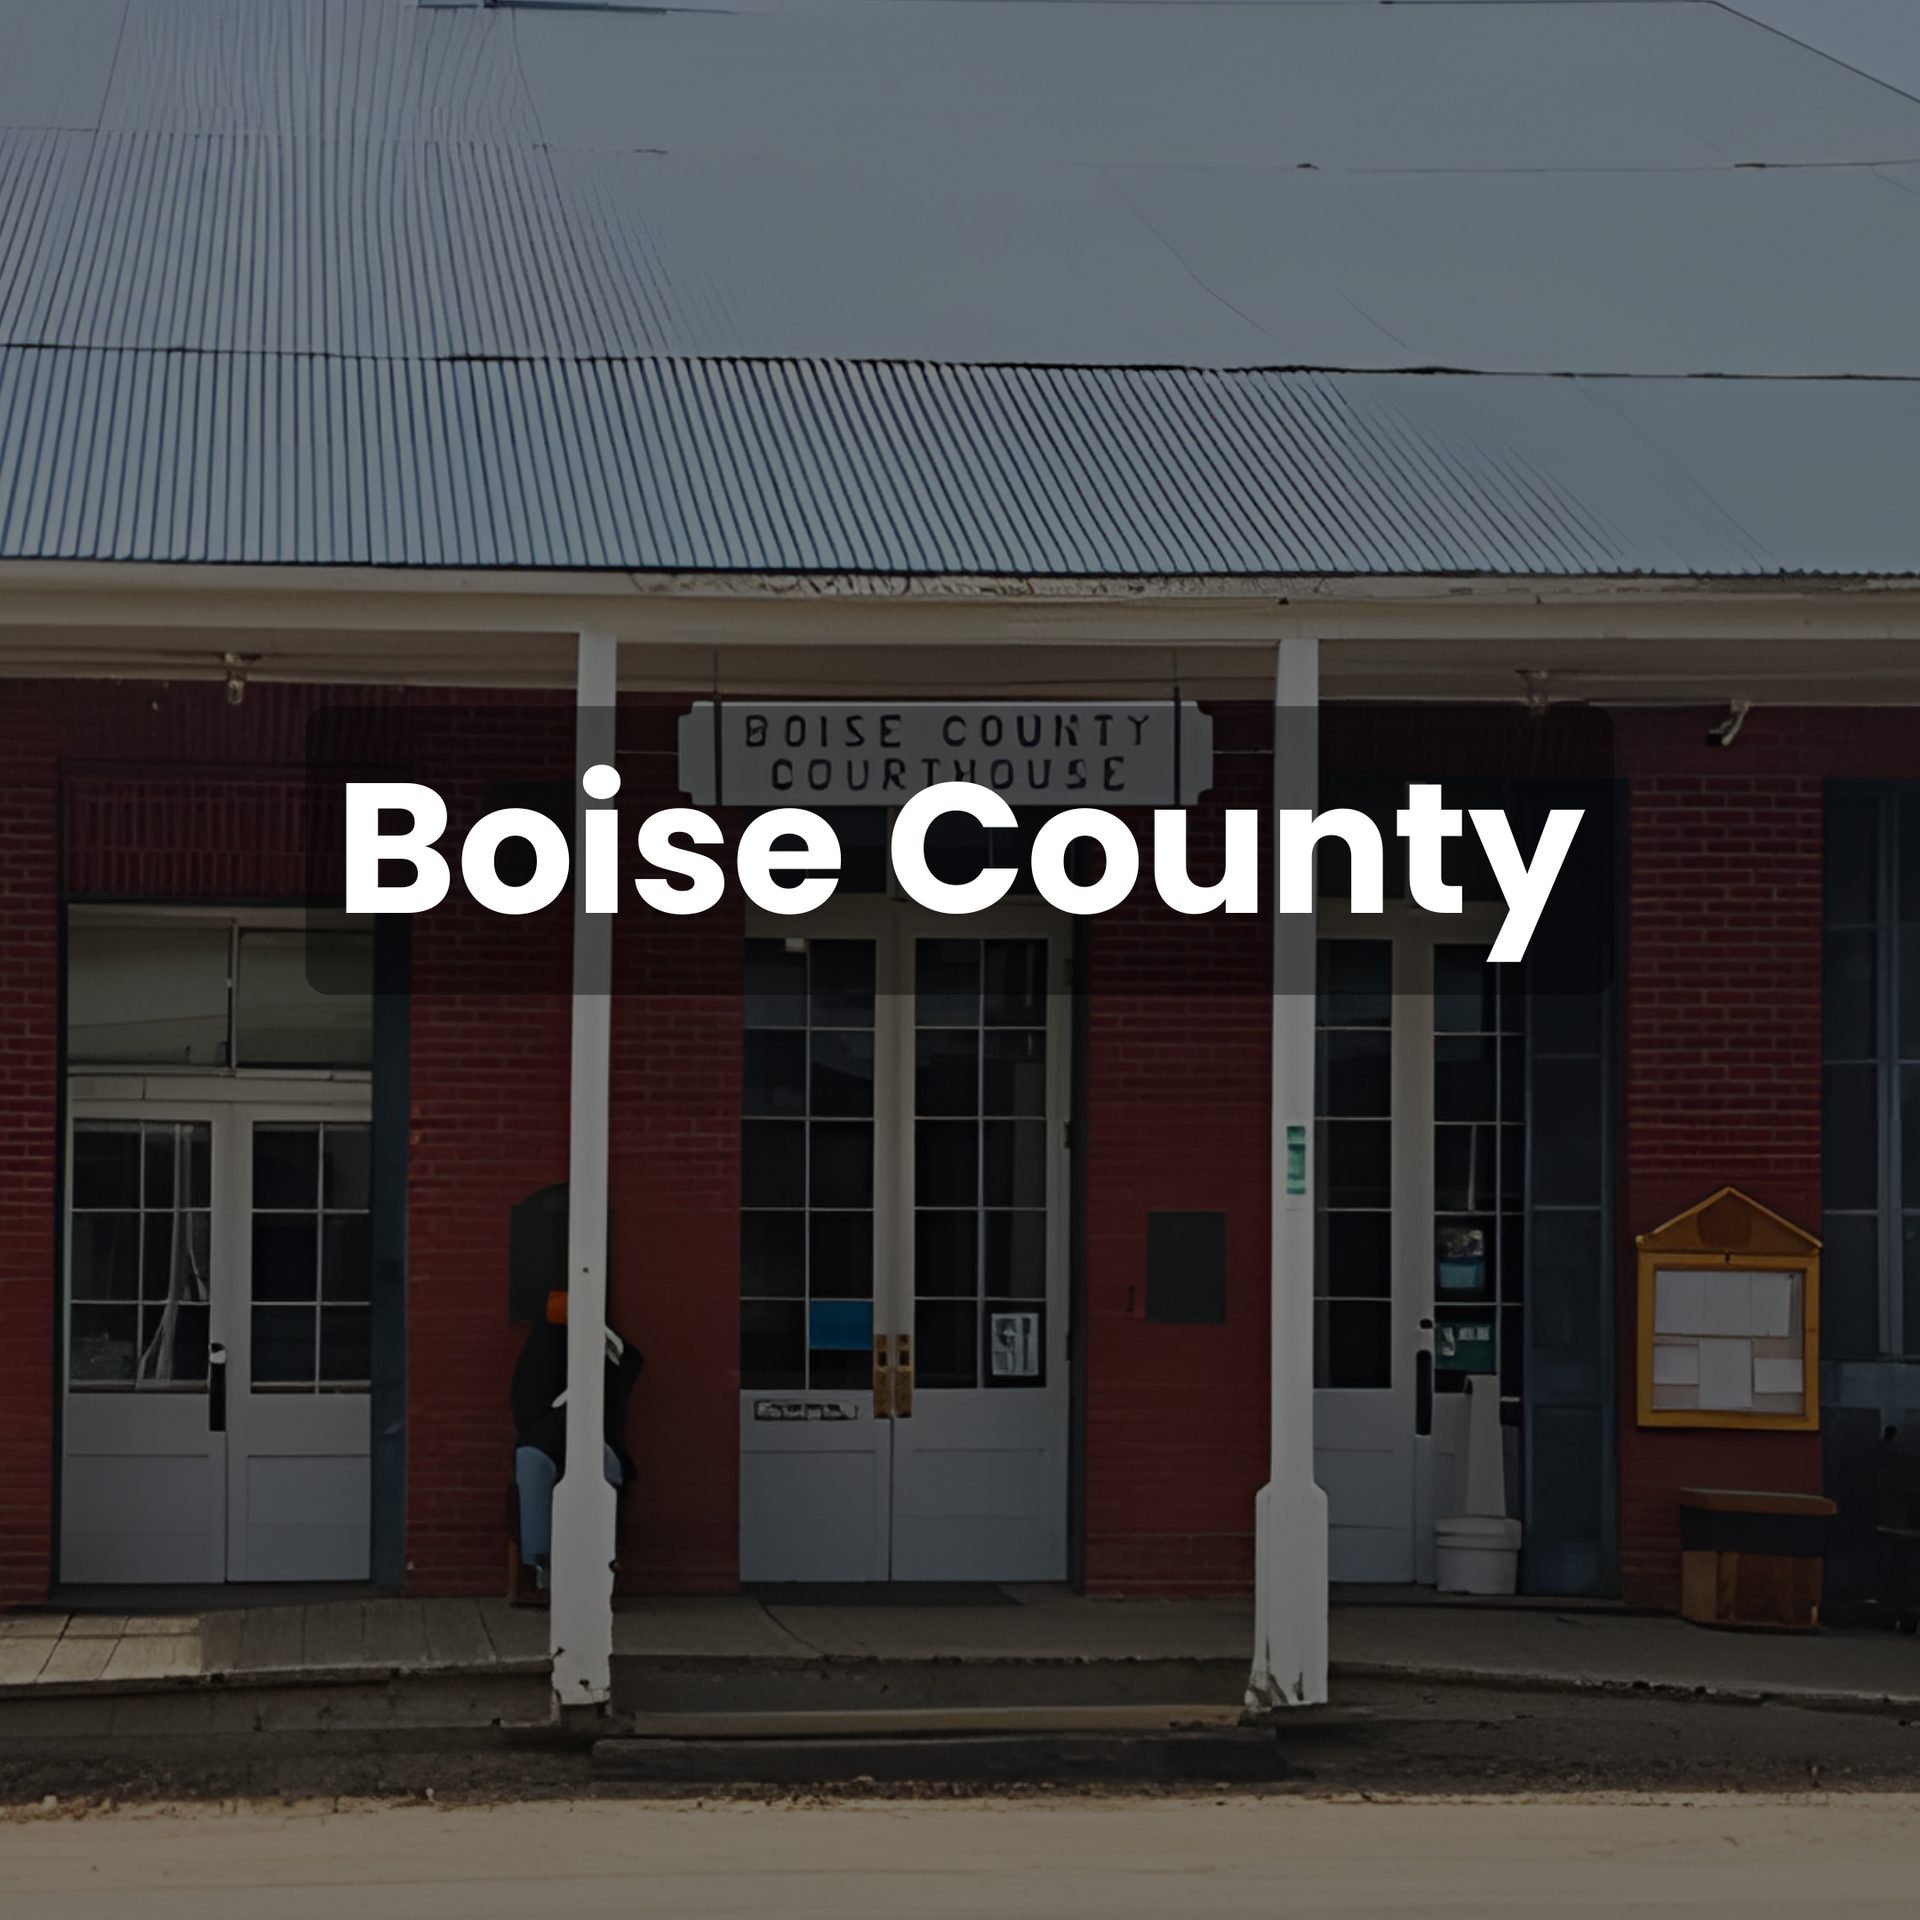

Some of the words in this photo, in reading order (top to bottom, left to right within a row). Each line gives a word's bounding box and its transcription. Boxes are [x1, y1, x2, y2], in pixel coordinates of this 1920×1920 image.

[744, 714, 903, 749] BOISE
[941, 713, 1150, 748] COUNTY
[770, 756, 1126, 792] COURTHOUSE
